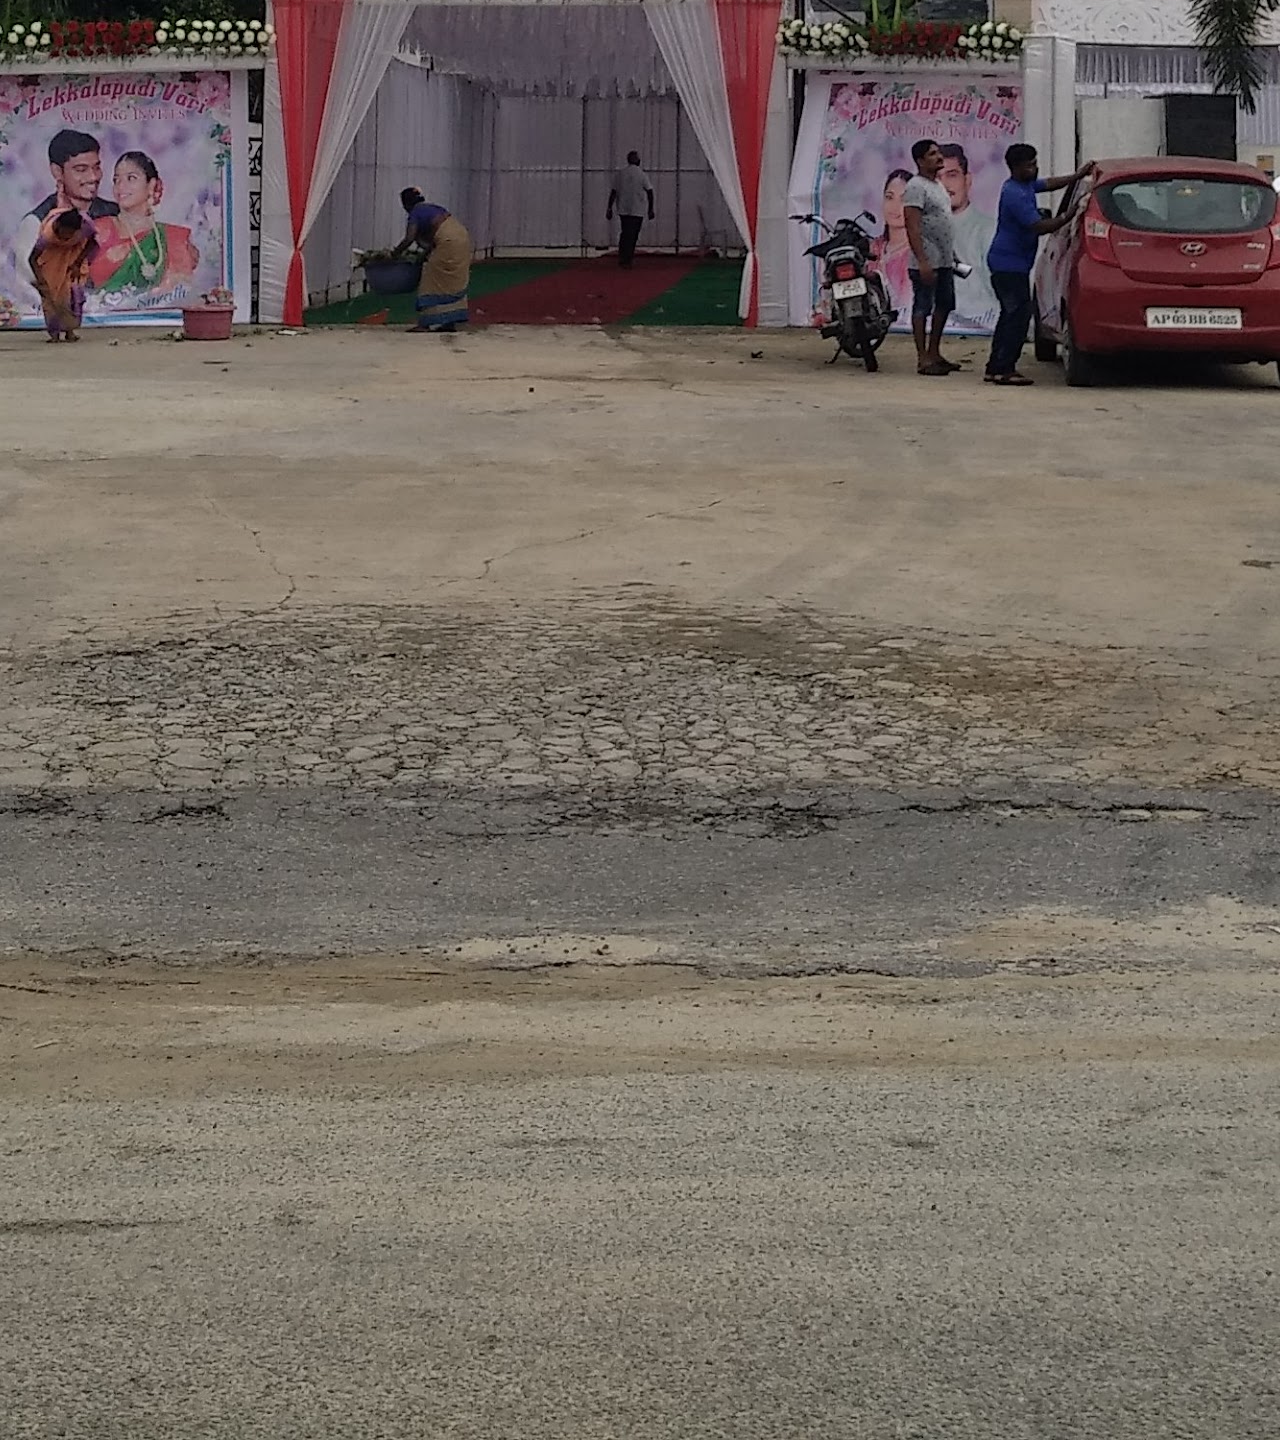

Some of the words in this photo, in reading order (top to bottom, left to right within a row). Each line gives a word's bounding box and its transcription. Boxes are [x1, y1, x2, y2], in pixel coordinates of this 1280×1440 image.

[162, 81, 208, 115] Vari
[976, 99, 1021, 136] Vari
[1151, 314, 1170, 325] AP
